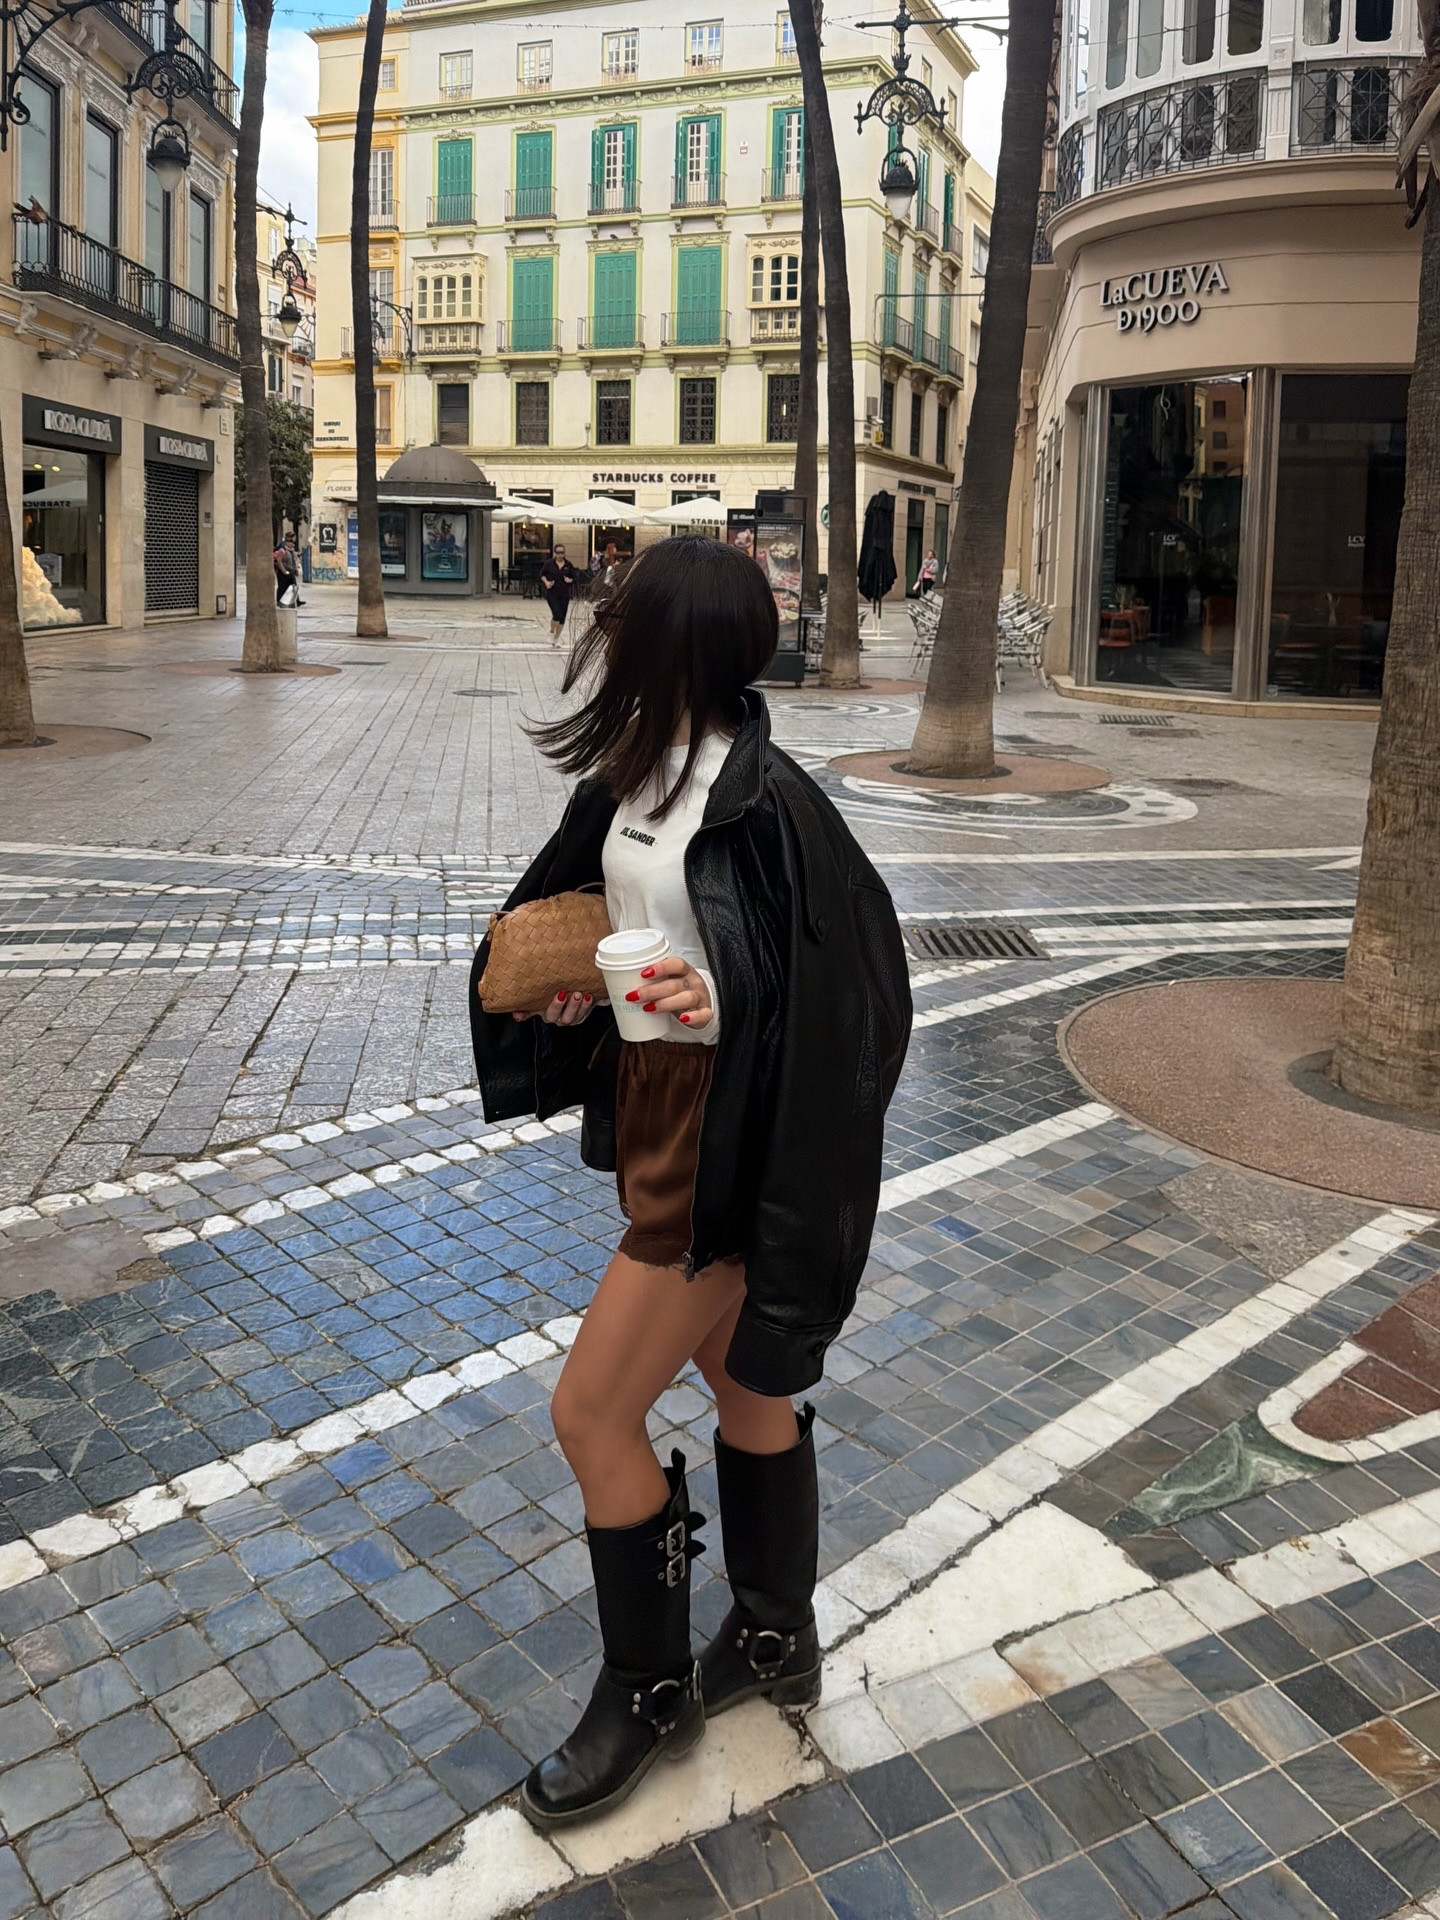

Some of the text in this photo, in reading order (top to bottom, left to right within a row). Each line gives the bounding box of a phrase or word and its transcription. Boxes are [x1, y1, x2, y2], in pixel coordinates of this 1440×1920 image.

[592, 473, 717, 483] STARBUCKS COFFEE
[571, 517, 618, 526] STARBUCKS
[628, 829, 656, 847] SANDER
